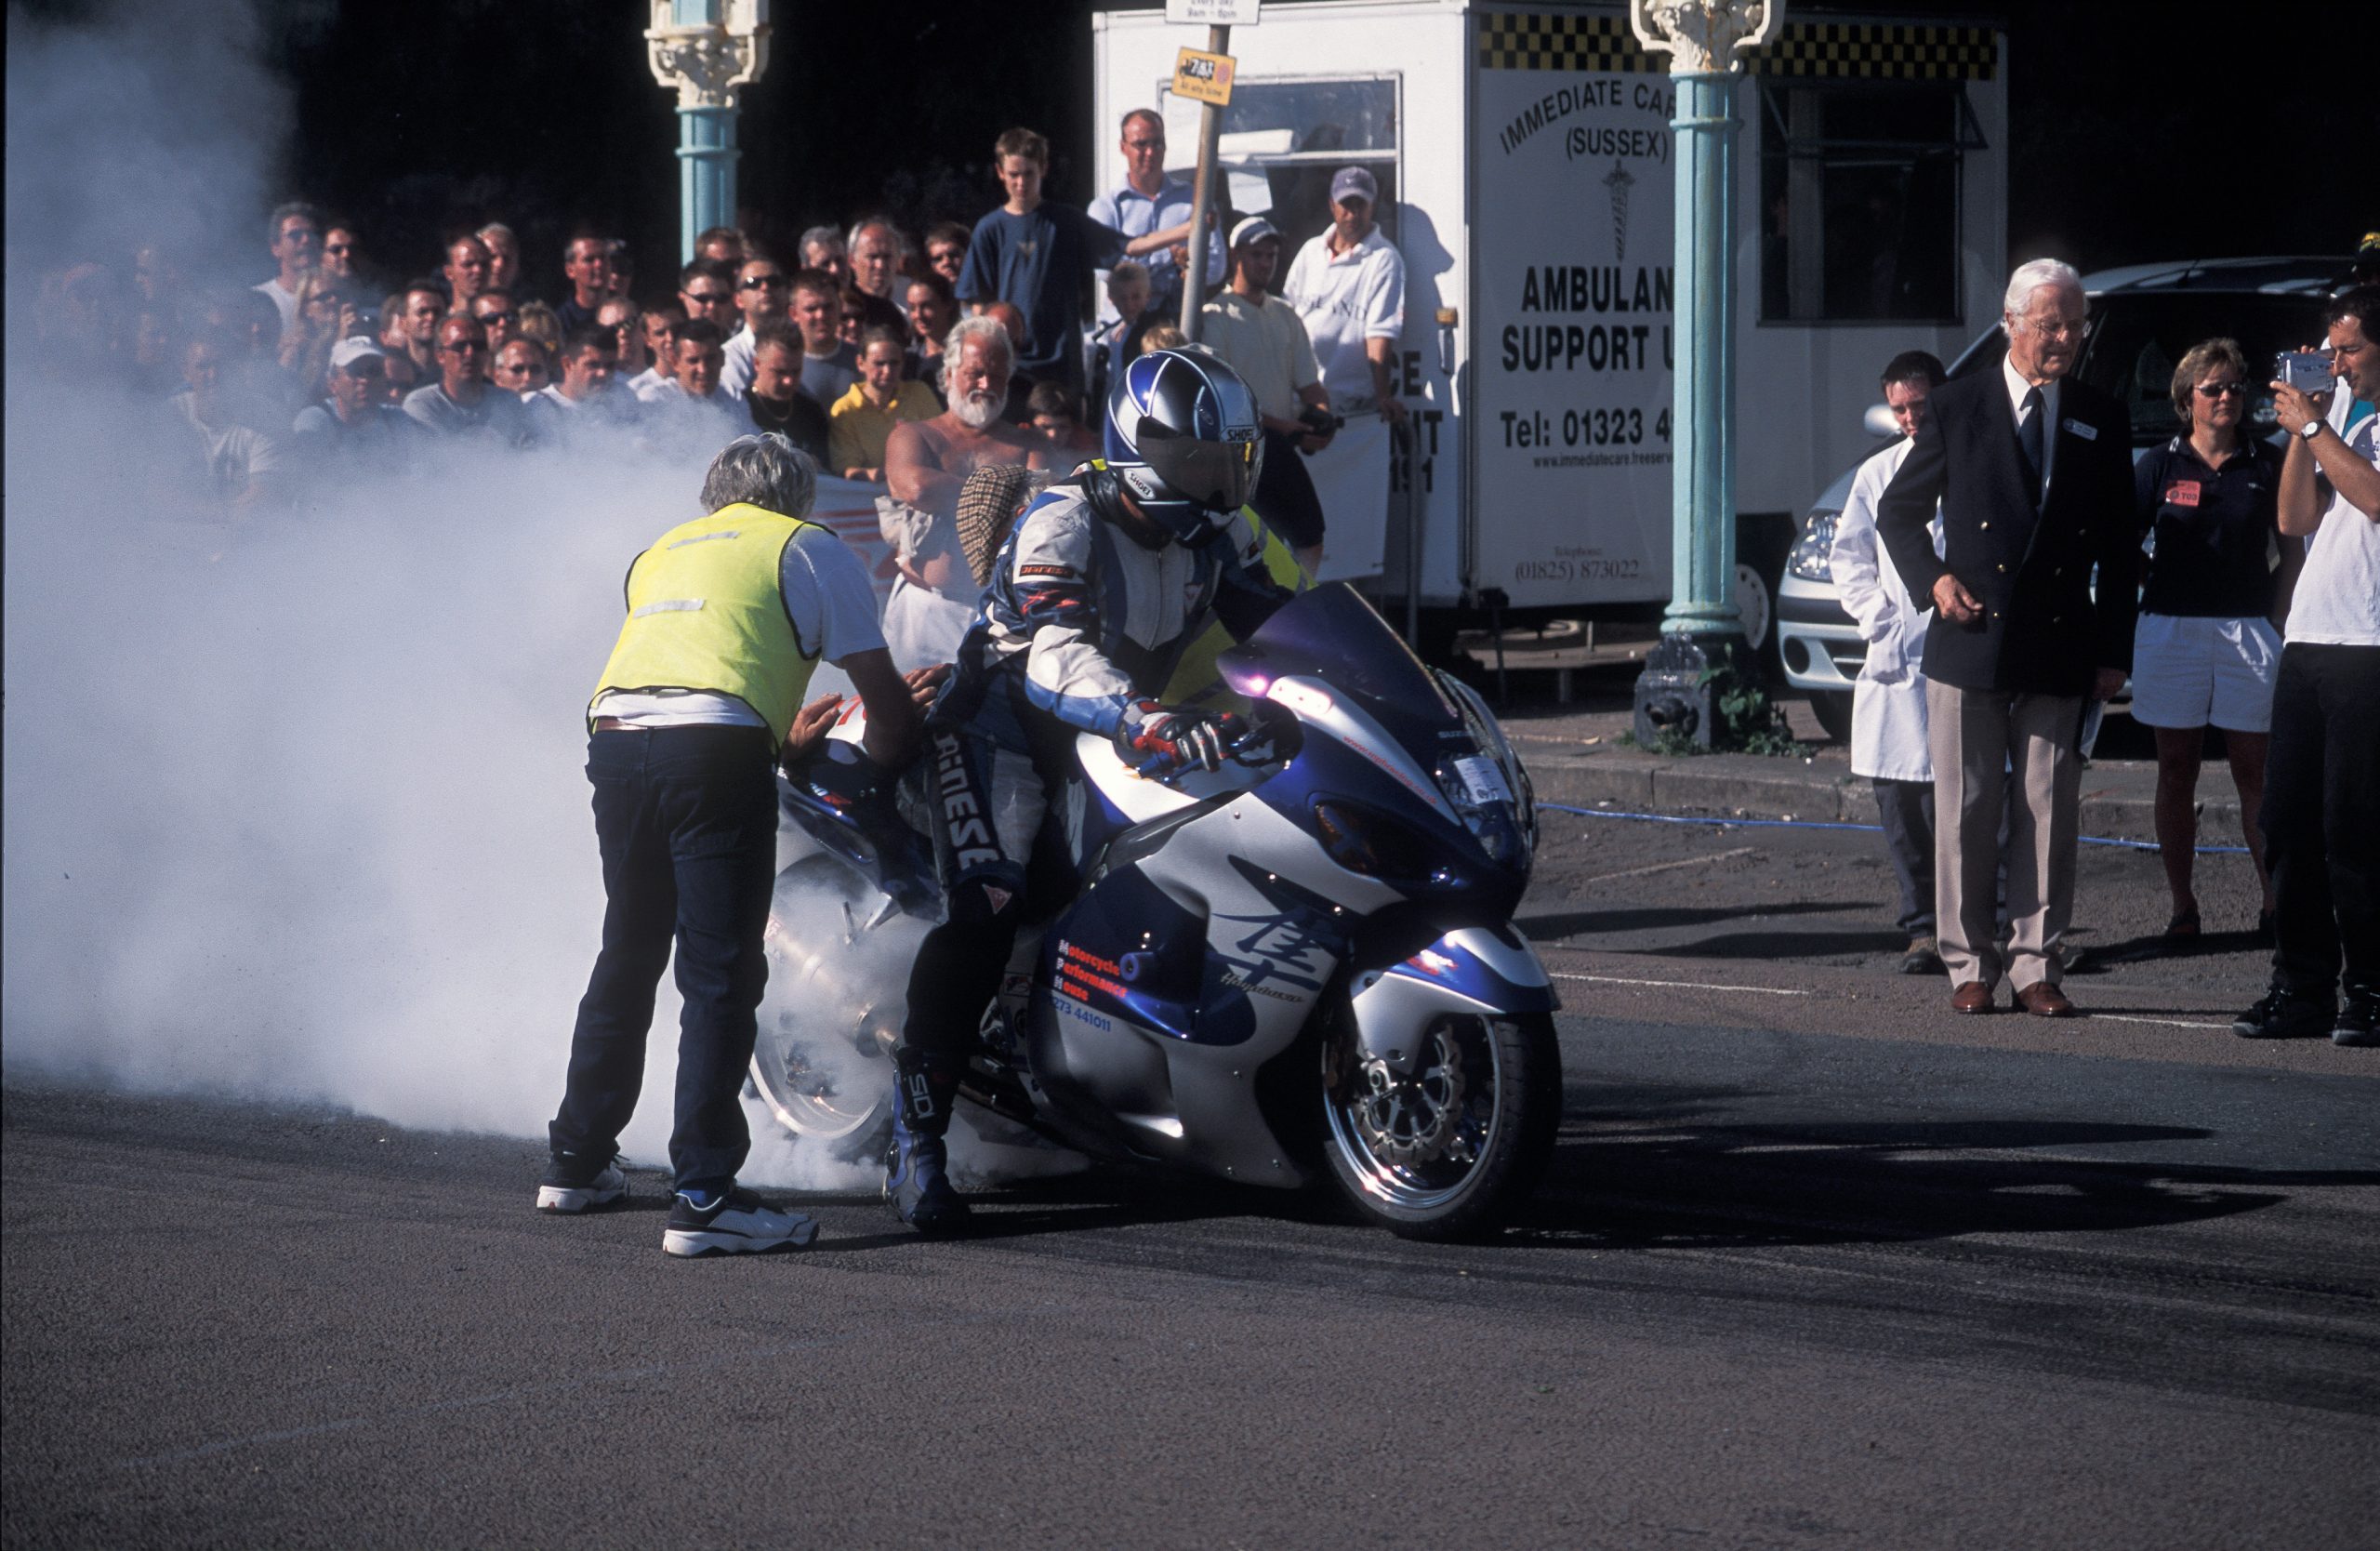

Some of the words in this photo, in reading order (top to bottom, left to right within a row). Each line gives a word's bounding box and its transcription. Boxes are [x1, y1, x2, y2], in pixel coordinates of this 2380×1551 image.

[1499, 79, 1623, 155] IMMEDIATE
[1633, 83, 1675, 119] CAR
[1566, 126, 1669, 164] (SUSSEX)
[1521, 266, 1673, 312] AMBULAN
[1502, 325, 1649, 372] SUPPORT
[1500, 410, 1551, 448] Tel:
[1563, 408, 1644, 447] 01323
[1130, 472, 1152, 497] SHOEI
[1515, 561, 1574, 583] (01825)
[1580, 559, 1639, 579] 873022
